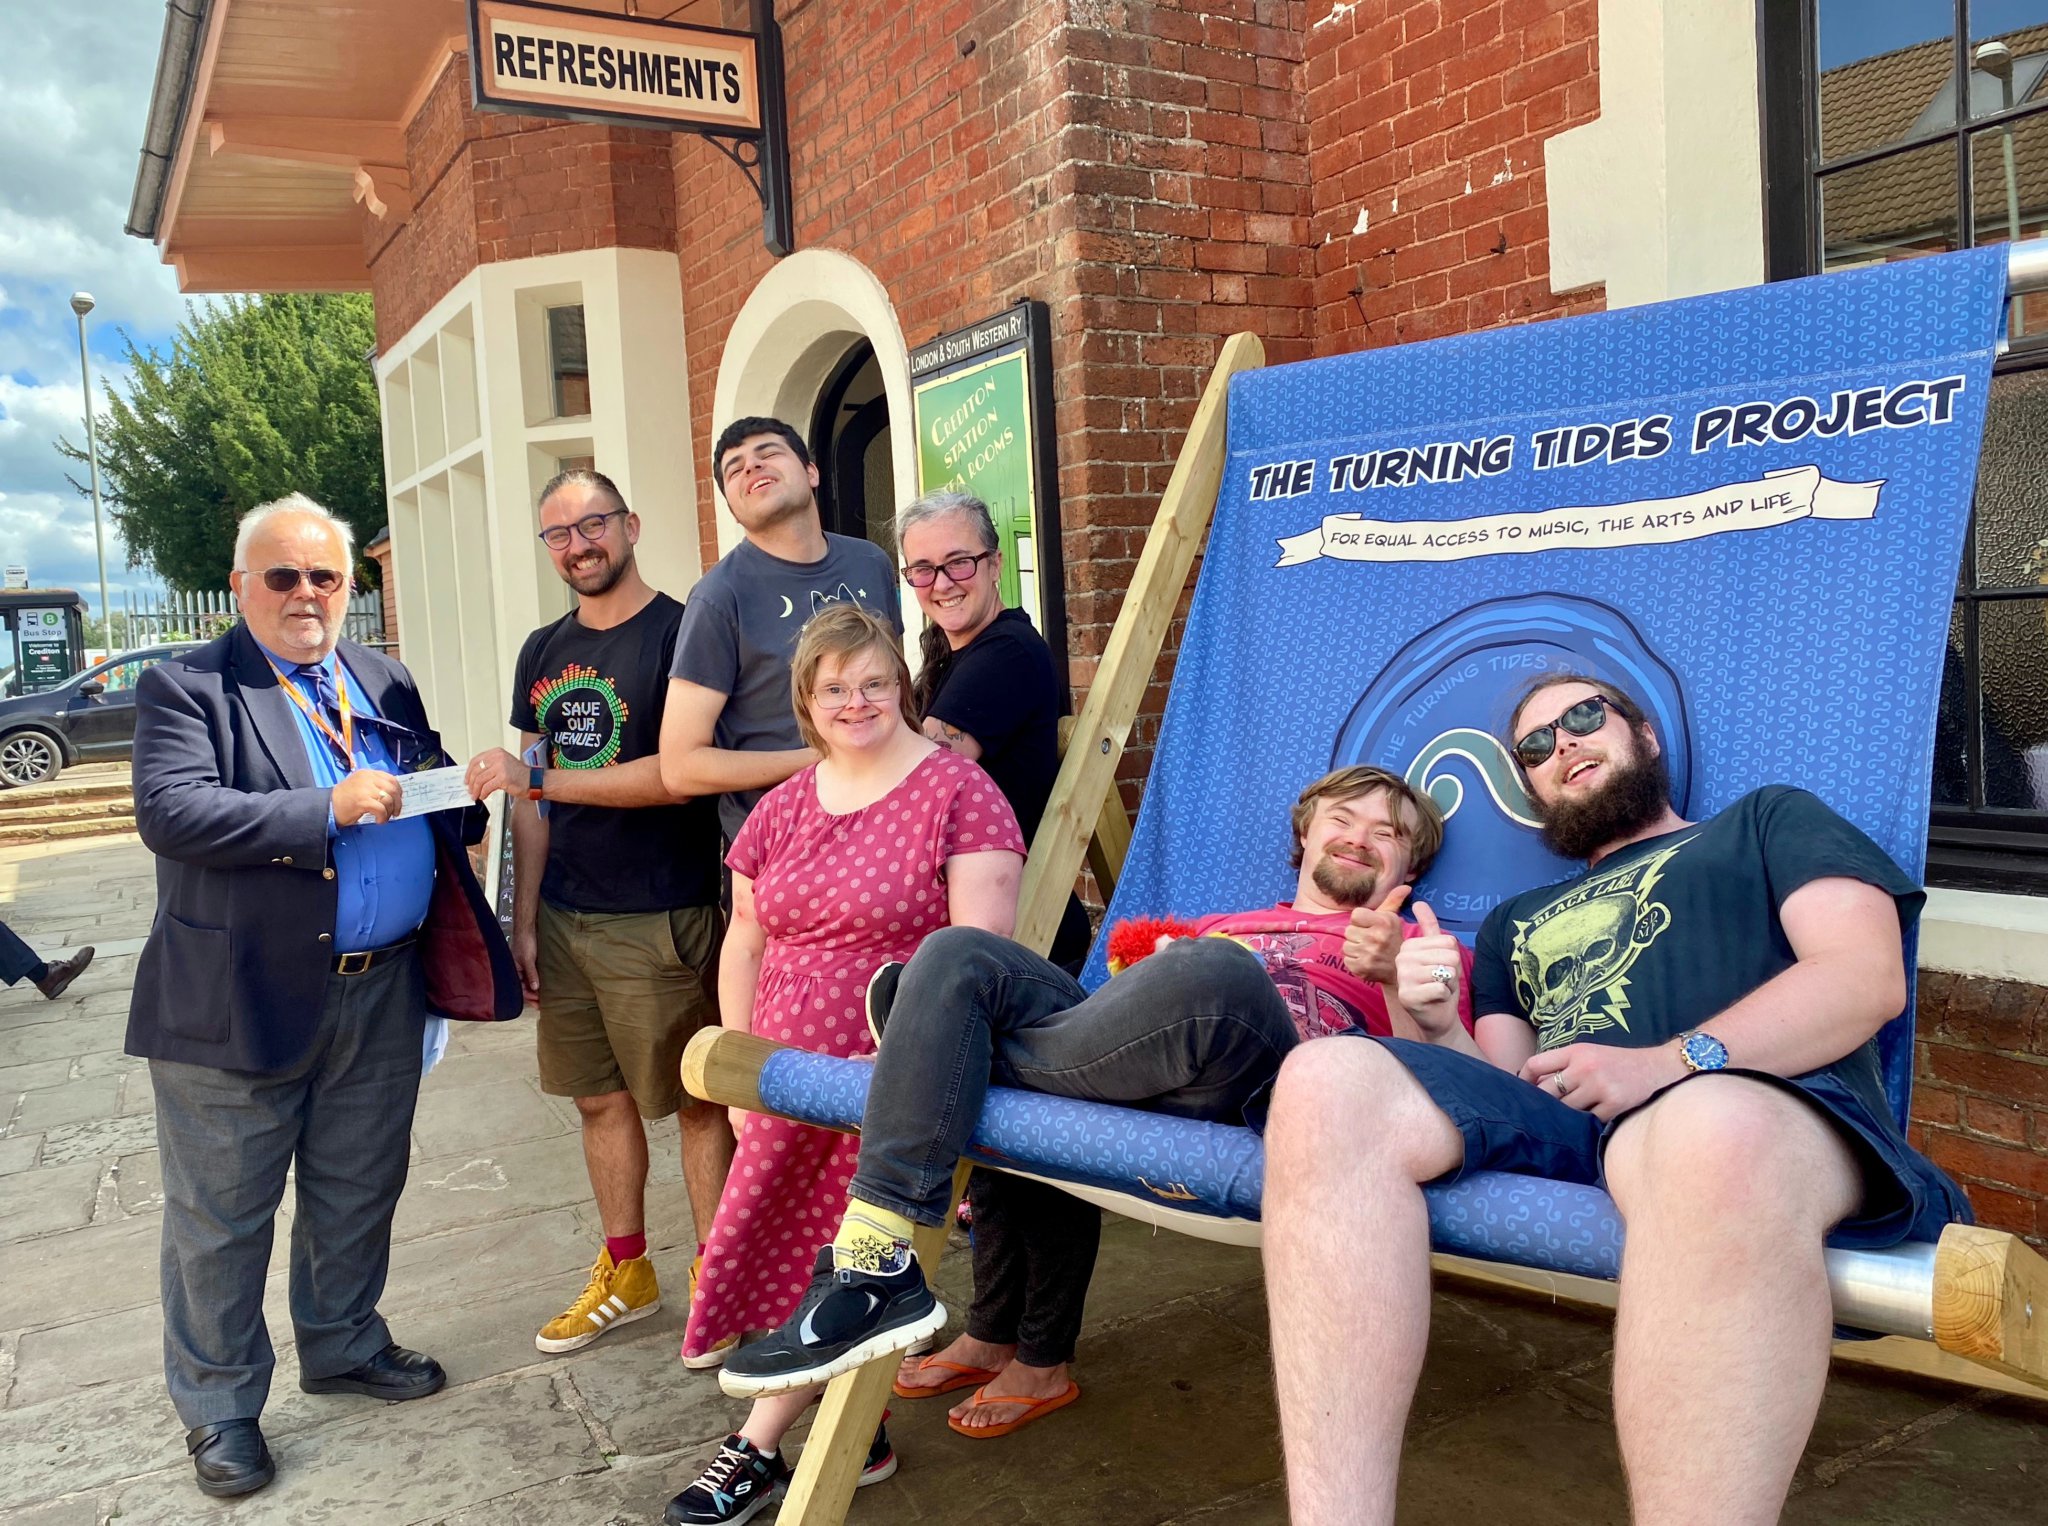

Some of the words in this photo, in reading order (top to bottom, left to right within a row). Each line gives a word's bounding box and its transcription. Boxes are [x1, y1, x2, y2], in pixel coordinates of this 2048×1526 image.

[494, 32, 741, 104] REFRESHMENTS
[910, 347, 939, 374] LONDON
[940, 343, 945, 362] &
[946, 336, 971, 360] SOUTH
[971, 321, 1009, 350] WESTERN
[931, 375, 996, 447] CREDITON
[944, 406, 998, 469] STATION
[1250, 459, 1316, 500] THE
[1329, 437, 1513, 492] TURNING
[1533, 414, 1673, 471] TIDES
[1692, 374, 1966, 454] PROJECT
[967, 426, 1014, 480] ROOMS
[1330, 532, 1360, 546] FOR
[1364, 531, 1417, 548] EQUAL
[1423, 529, 1489, 546] ACCESS
[1497, 526, 1522, 540] TO
[1528, 520, 1590, 537] MUSIC,
[1598, 514, 1635, 533] THE
[1642, 510, 1696, 529] ARTS
[1702, 499, 1744, 521] AND
[1750, 490, 1793, 511] LIFE
[23, 629, 40, 637] Bus
[42, 629, 62, 637] Stop
[46, 614, 54, 624] B
[561, 701, 601, 717] SAVE
[567, 717, 596, 732] OUR
[1379, 733, 1406, 768] THE
[1403, 663, 1480, 728] TURNING
[1488, 653, 1548, 671] TIDES
[554, 731, 602, 748] VENUES
[1534, 889, 1591, 928] BLACK
[1592, 868, 1641, 898] LABEL
